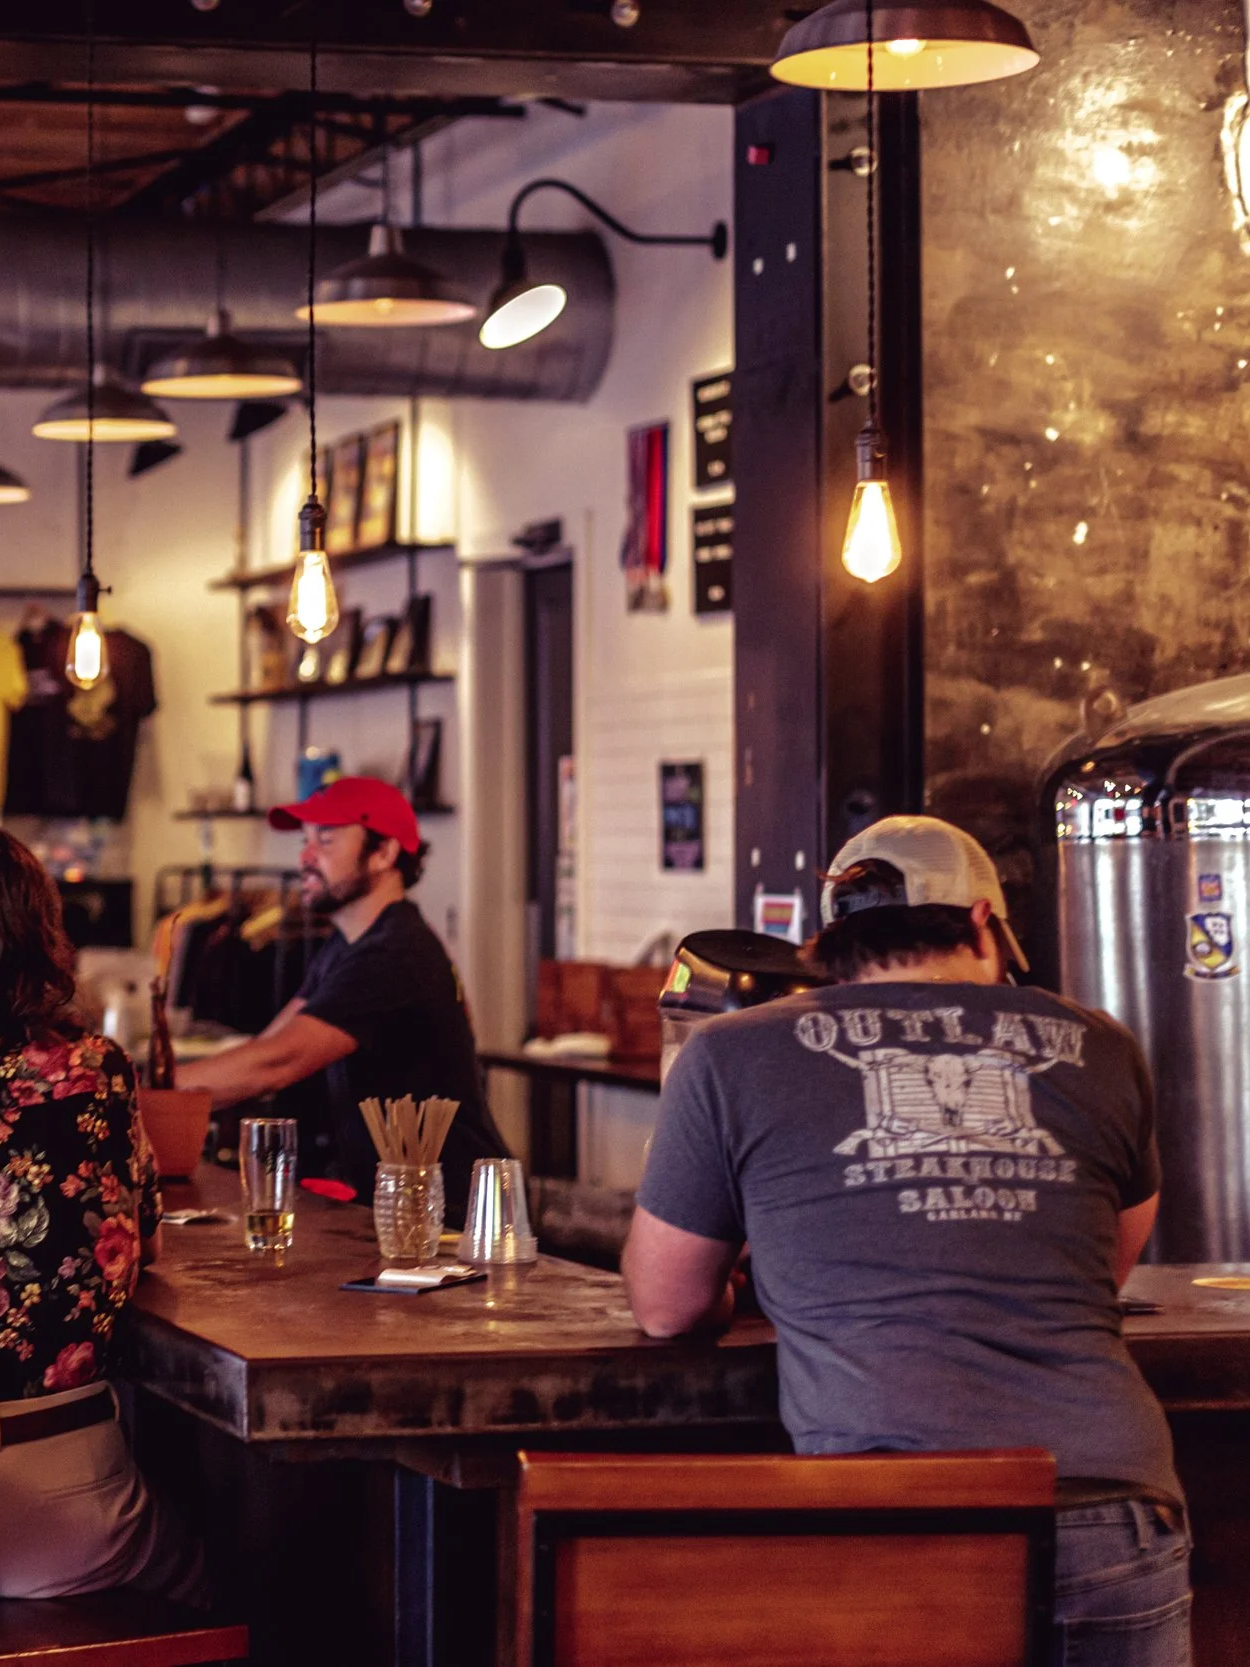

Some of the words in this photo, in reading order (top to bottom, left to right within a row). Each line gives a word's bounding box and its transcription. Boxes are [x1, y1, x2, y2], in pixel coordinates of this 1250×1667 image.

[794, 1005, 1086, 1068] OUTLAW
[843, 1155, 1078, 1187] STEAKHOUSE
[897, 1186, 1038, 1213] SALOON
